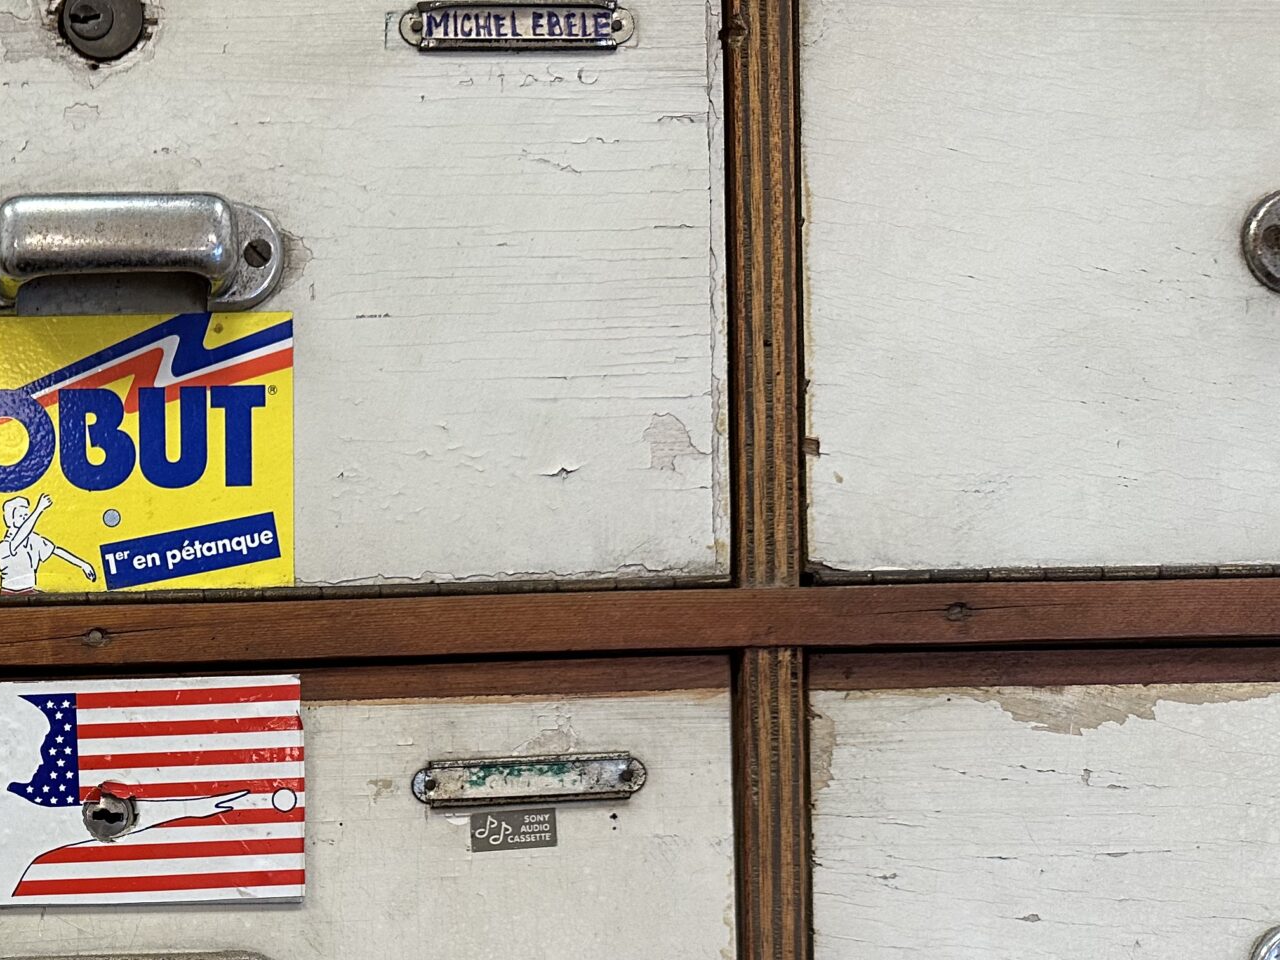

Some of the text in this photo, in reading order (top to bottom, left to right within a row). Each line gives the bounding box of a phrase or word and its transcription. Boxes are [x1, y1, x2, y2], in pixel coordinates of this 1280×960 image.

[425, 11, 612, 38] MICHEL EBELE
[105, 529, 274, 575] 1er en pétanque
[523, 813, 551, 823] SONY
[520, 823, 550, 833] AUDIO
[507, 832, 552, 844] CASSETTE
